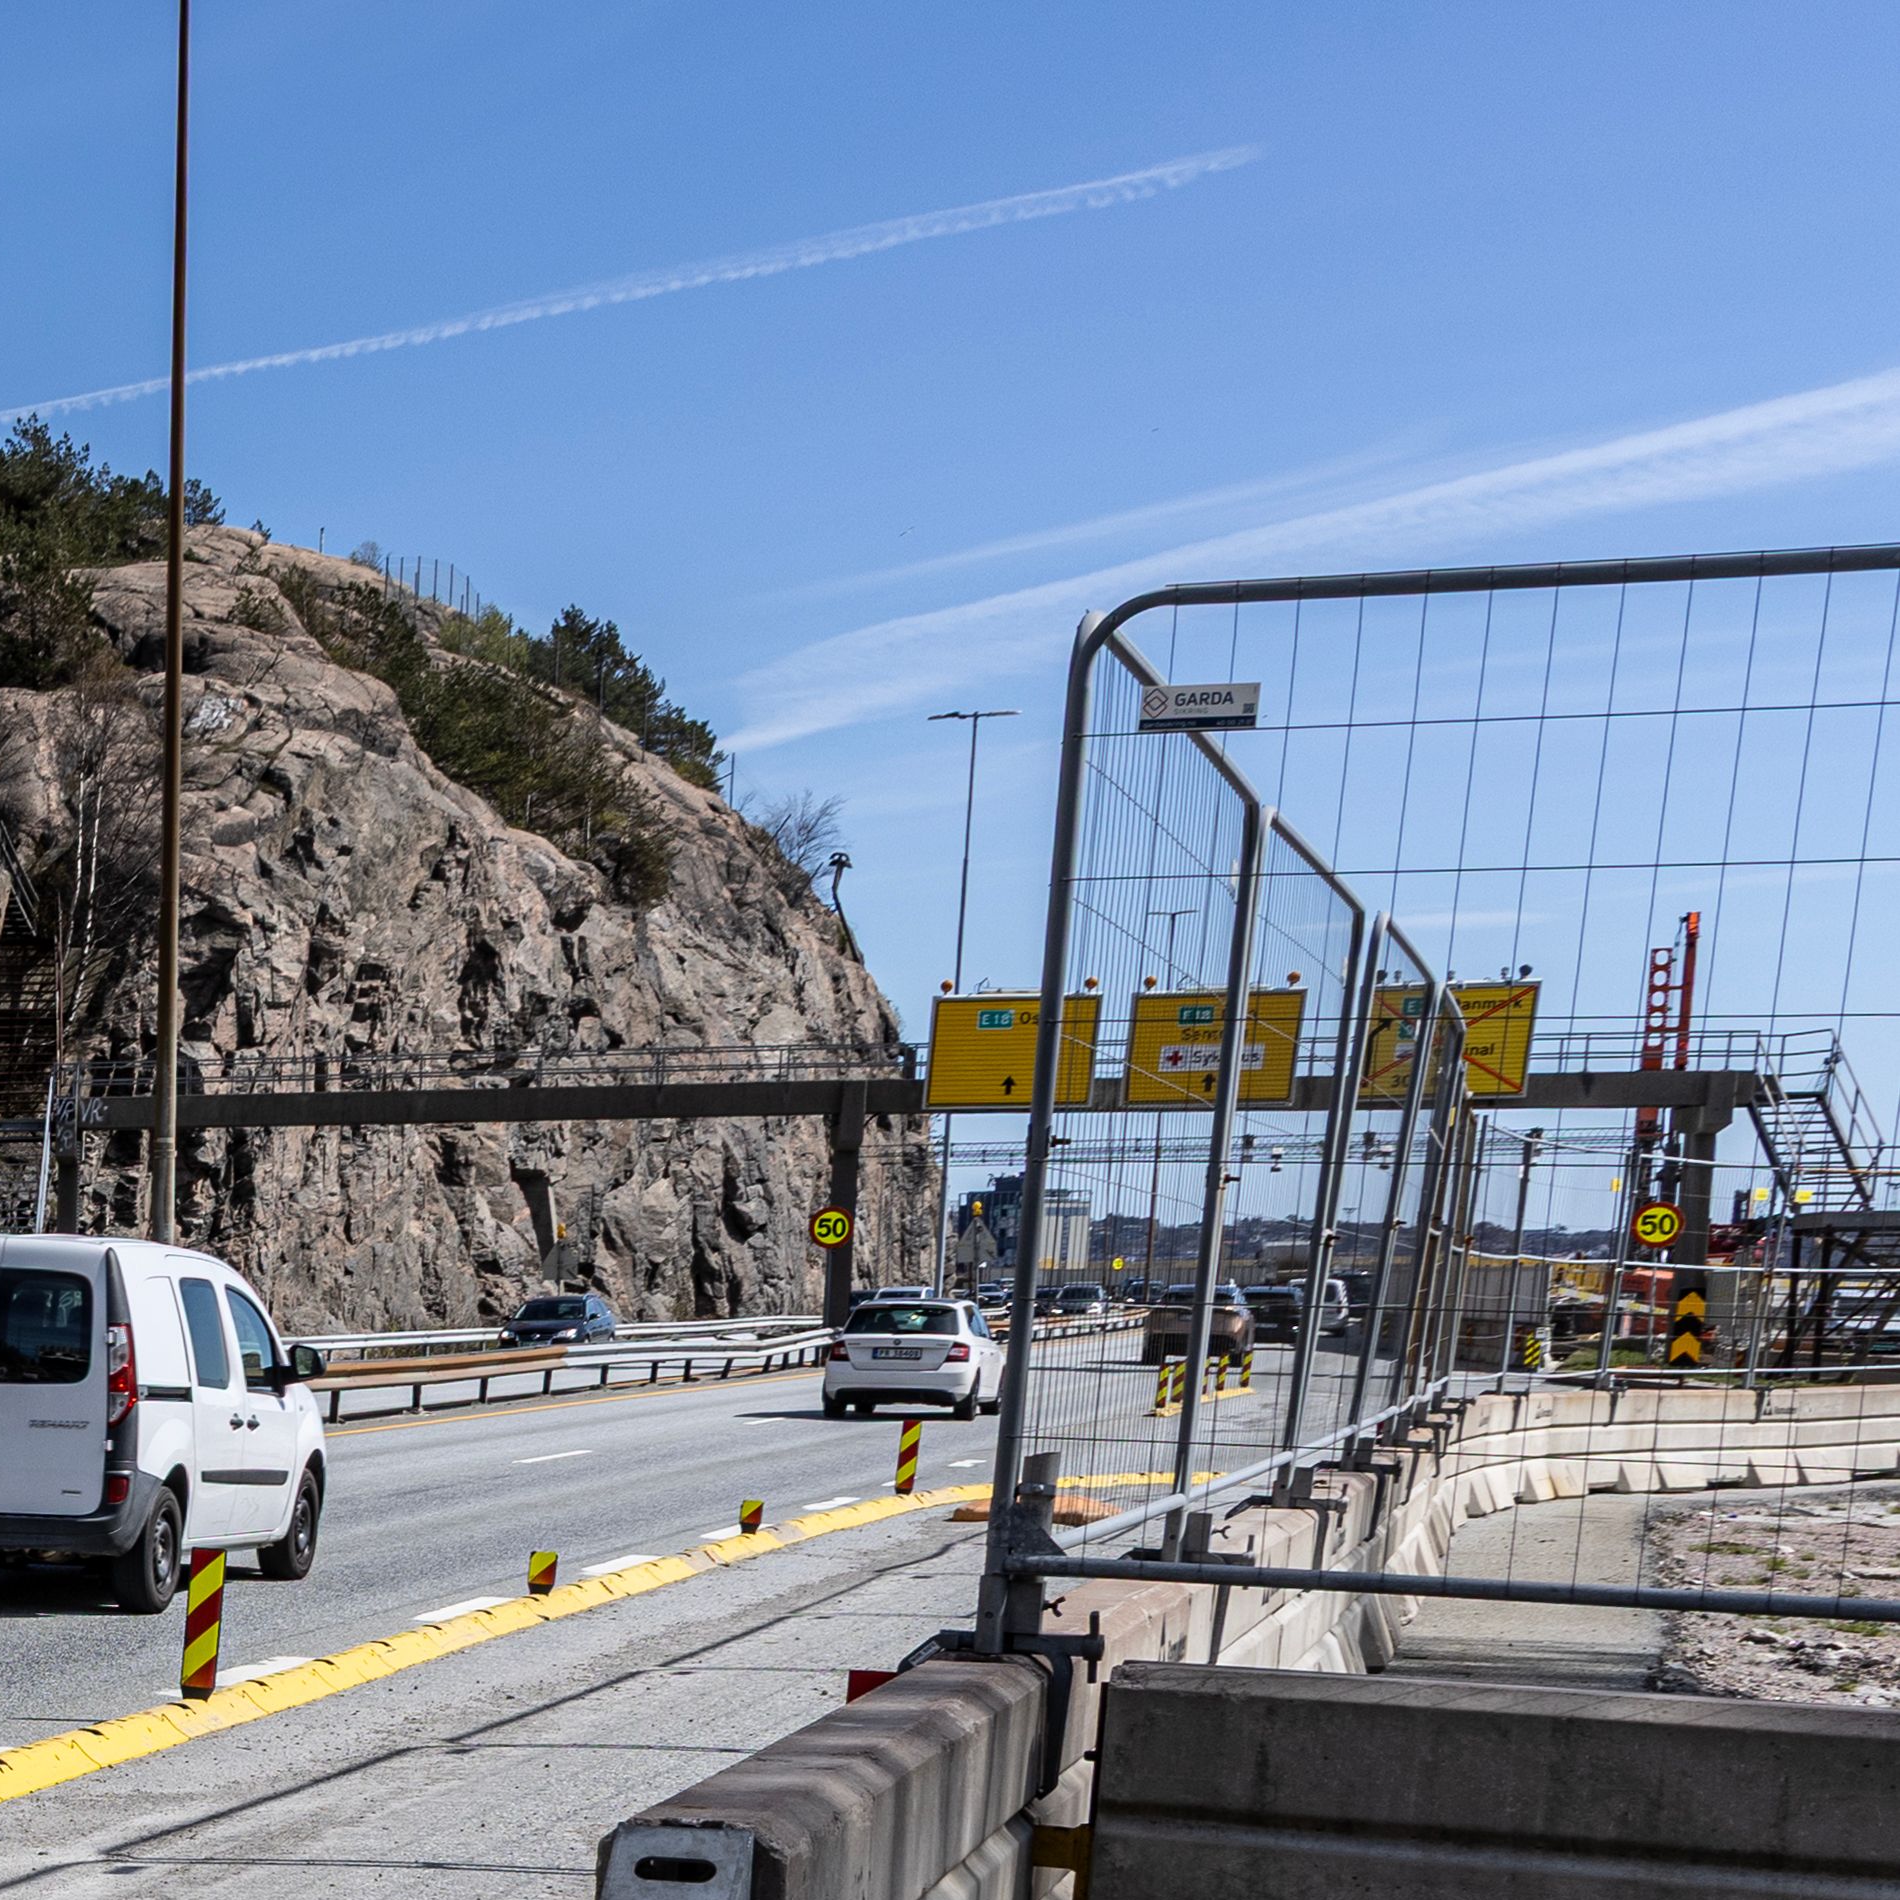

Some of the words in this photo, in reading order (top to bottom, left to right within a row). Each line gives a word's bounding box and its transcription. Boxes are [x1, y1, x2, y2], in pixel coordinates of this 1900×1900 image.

[1174, 691, 1234, 706] GARDA
[981, 1014, 989, 1025] E
[1191, 1051, 1260, 1067] Sykus
[817, 1217, 847, 1238] 50
[1640, 1213, 1676, 1236] 50
